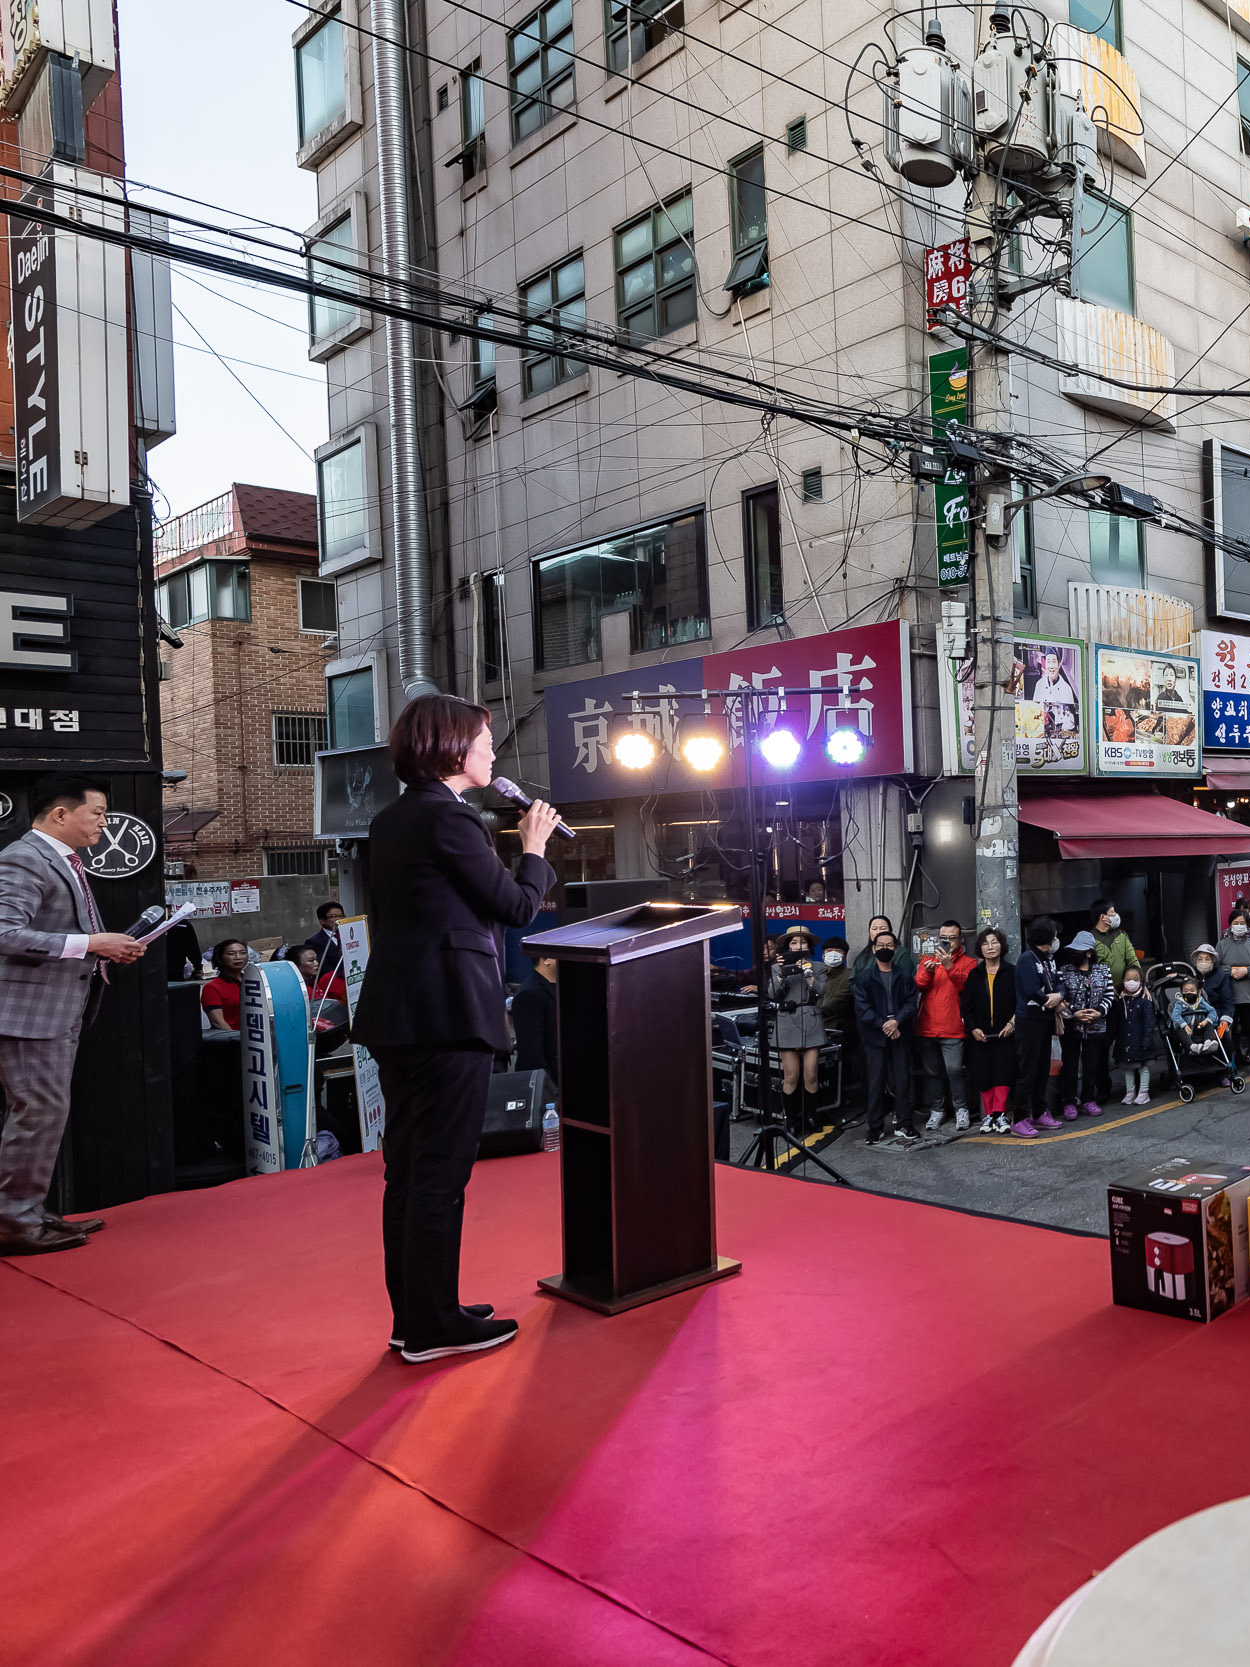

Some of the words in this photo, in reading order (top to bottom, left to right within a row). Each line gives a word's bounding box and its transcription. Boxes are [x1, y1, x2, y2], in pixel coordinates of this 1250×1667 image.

[18, 231, 49, 285] Daejin
[24, 284, 48, 501] STYLE
[1104, 747, 1123, 758] KBS
[133, 824, 151, 846] HAIR
[244, 979, 272, 1147] 로뎀고시텔
[1111, 1195, 1124, 1205] CUBE
[1188, 1307, 1202, 1318] 3.5L
